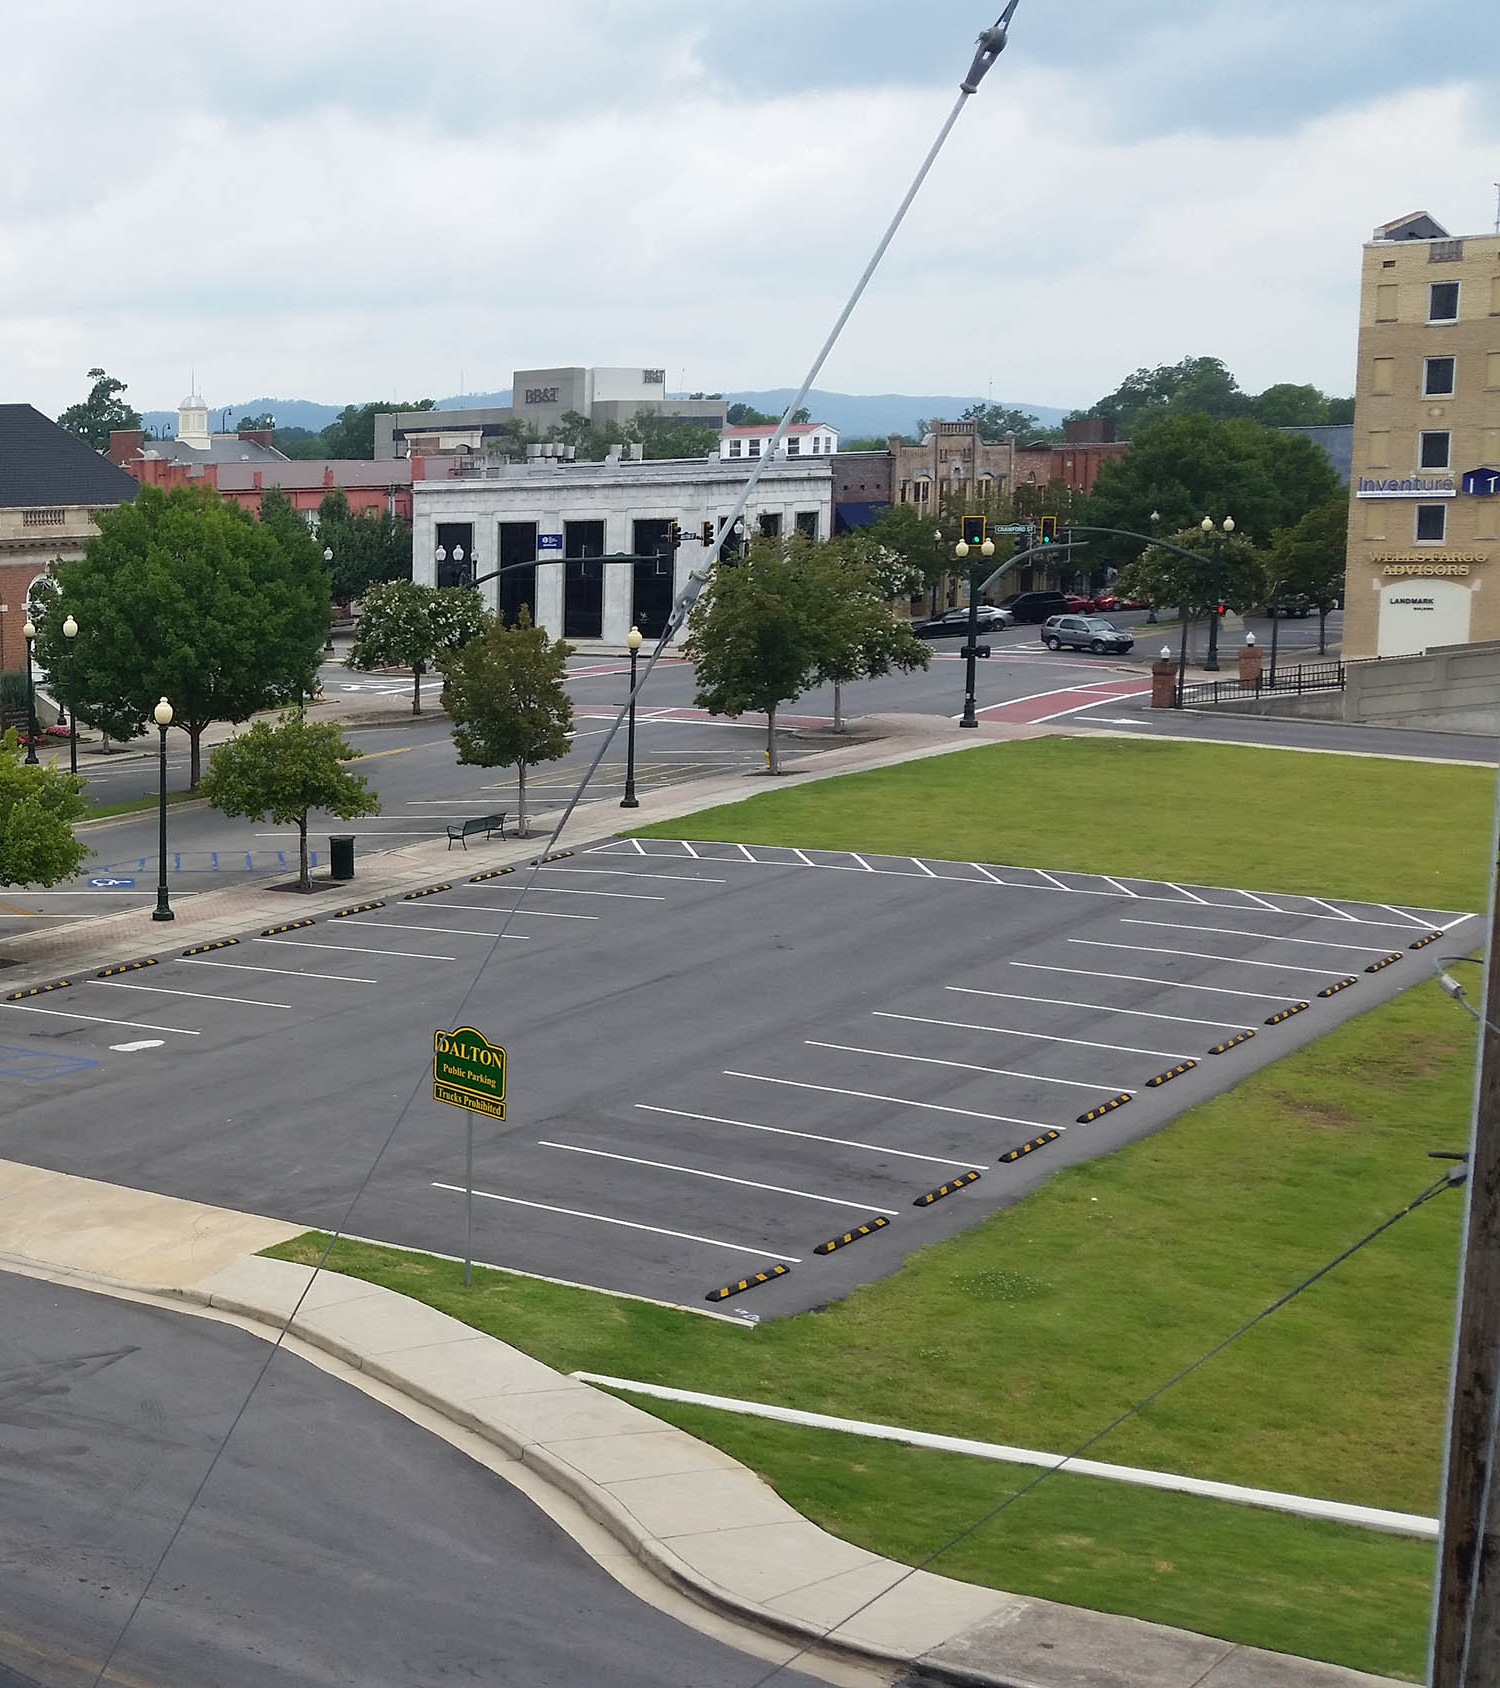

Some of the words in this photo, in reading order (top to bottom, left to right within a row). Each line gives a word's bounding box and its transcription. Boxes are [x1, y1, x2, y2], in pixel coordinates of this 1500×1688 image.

[525, 387, 560, 404] BB&T
[1358, 476, 1454, 491] Inventure
[1369, 551, 1426, 562] WELLS
[1430, 551, 1488, 562] FARGO
[1382, 564, 1470, 576] ADVISORS
[439, 1037, 502, 1069] DALTON
[443, 1063, 466, 1078] Public
[467, 1070, 497, 1089] Parking
[438, 1087, 462, 1103] Trucks
[463, 1096, 502, 1116] Prohibited
